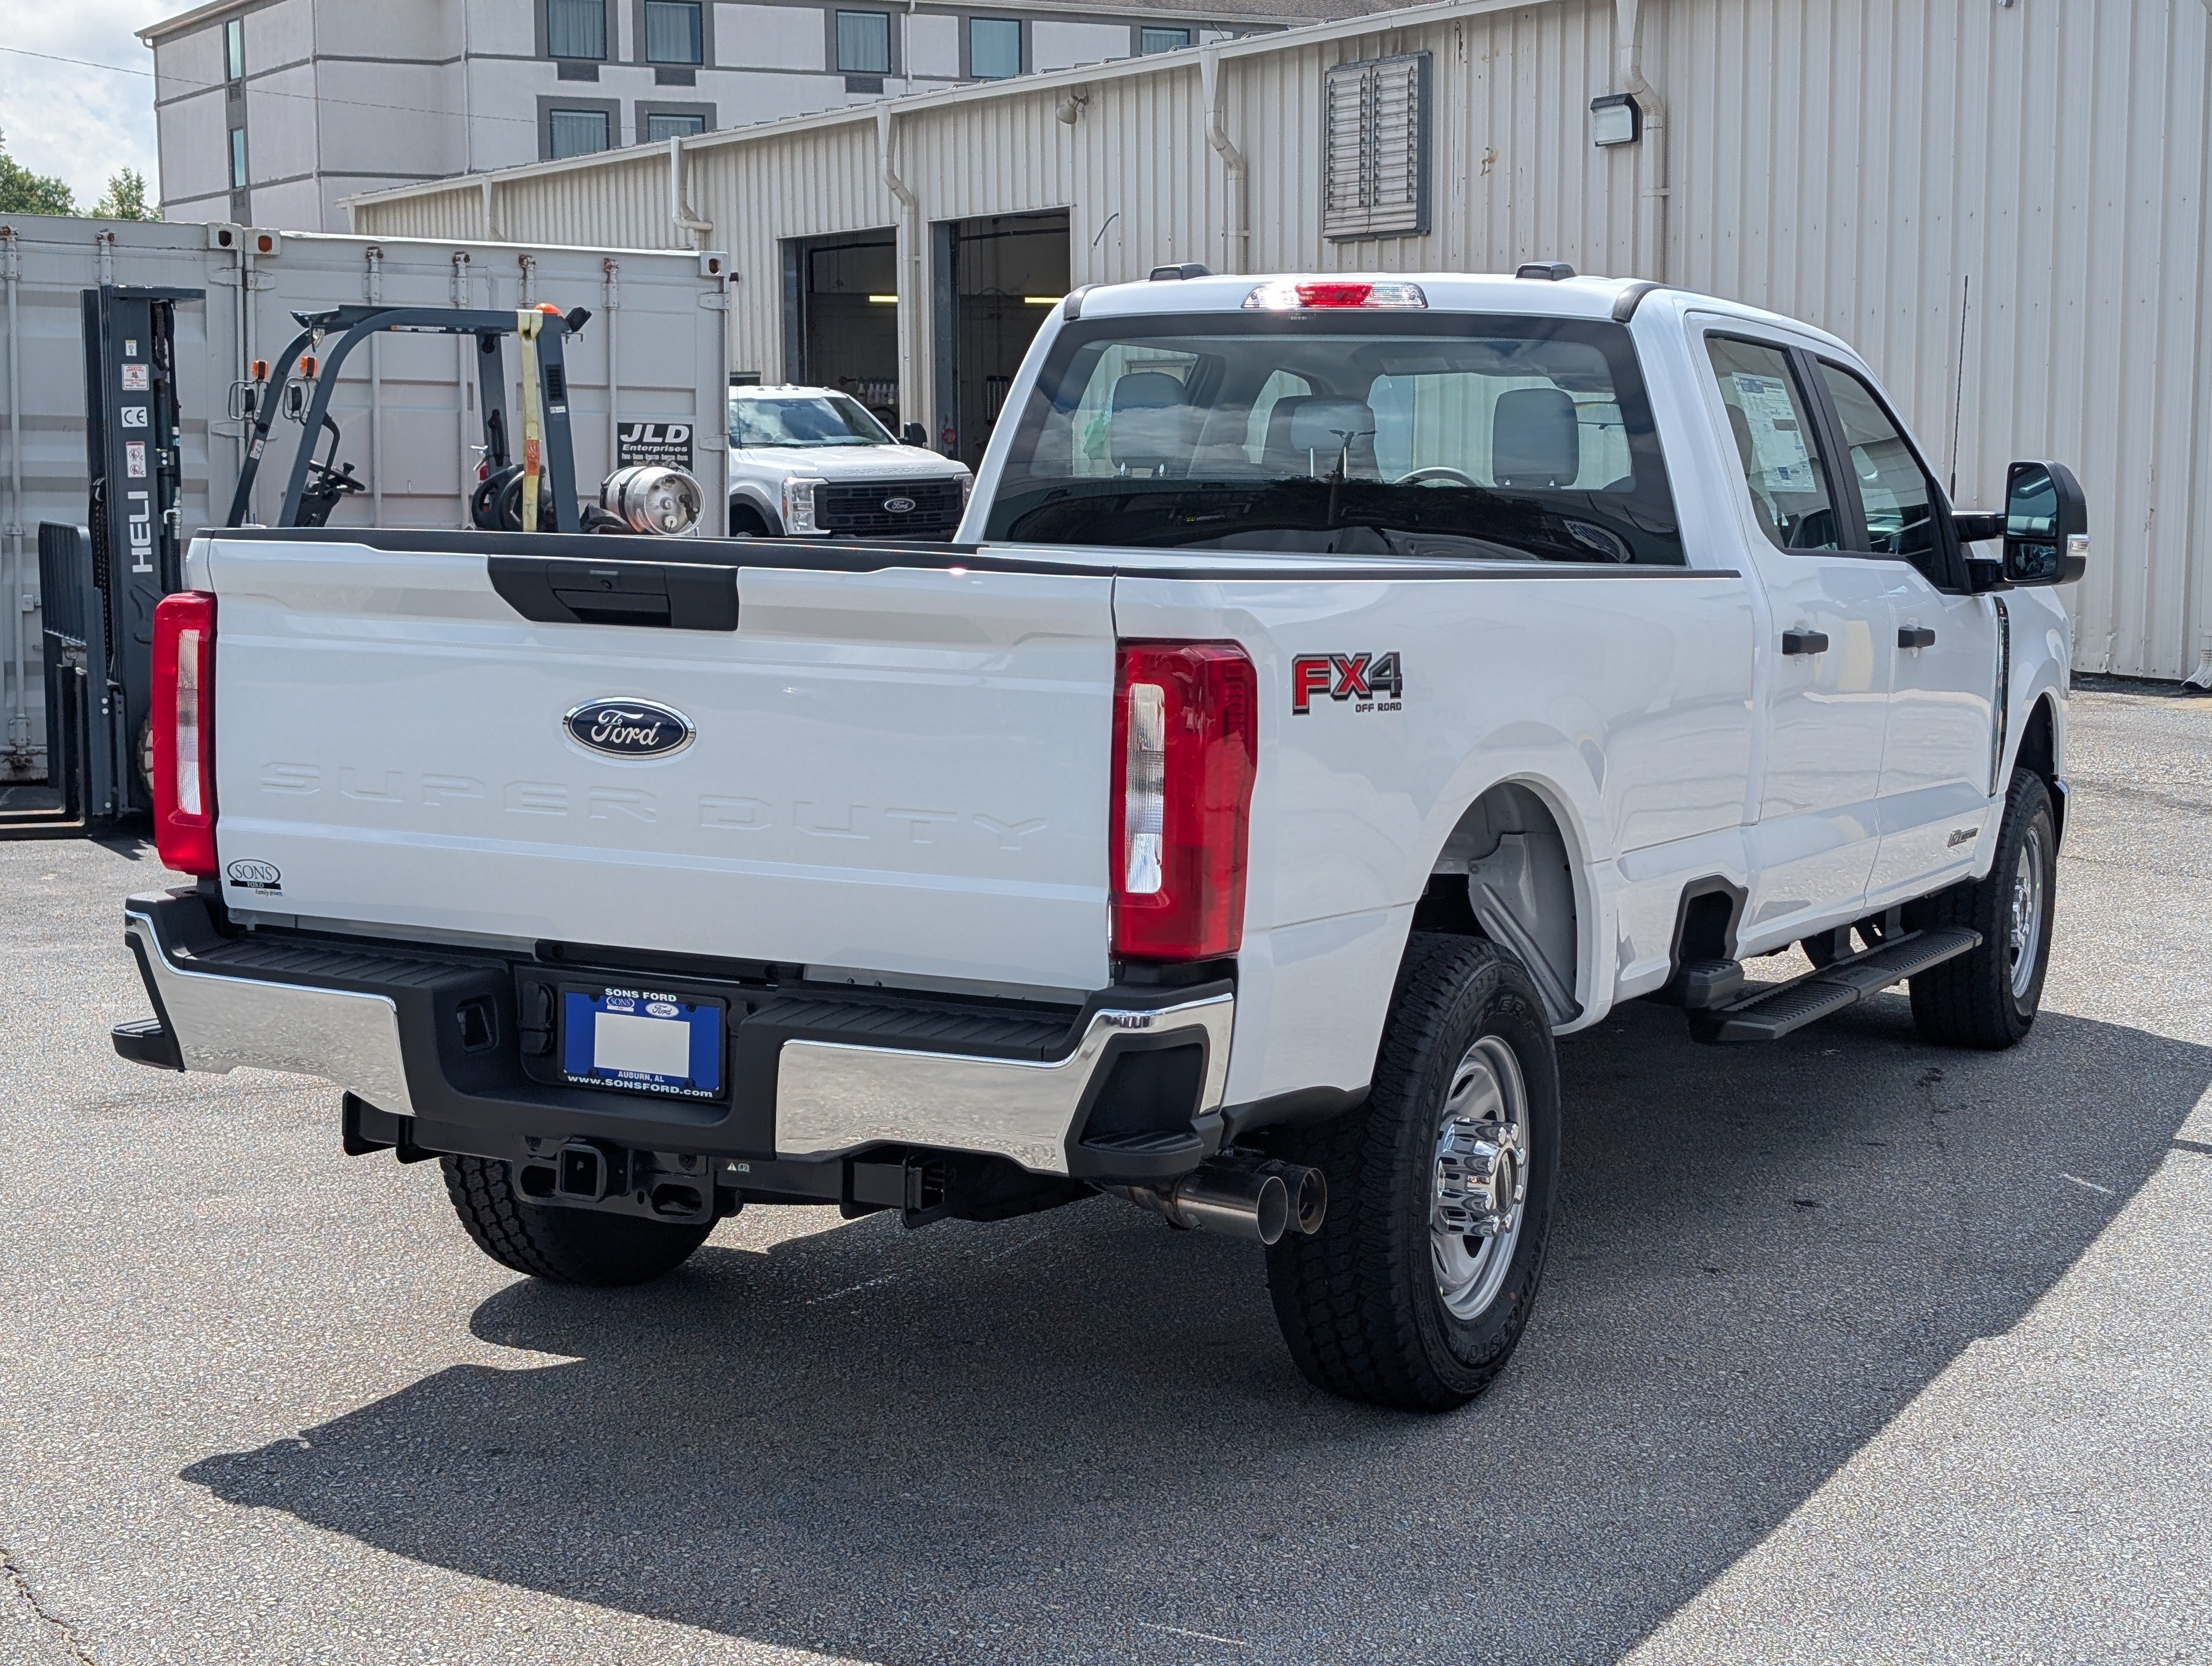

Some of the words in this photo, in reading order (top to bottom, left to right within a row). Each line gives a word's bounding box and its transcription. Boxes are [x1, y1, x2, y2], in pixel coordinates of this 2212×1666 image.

[620, 424, 690, 443] JLD
[622, 444, 687, 452] Enterprises
[892, 500, 909, 509] Ford
[127, 491, 153, 573] HELI
[1292, 651, 1403, 716] FX4
[1355, 703, 1374, 713] OFF
[1377, 702, 1402, 712] ROAD
[591, 709, 662, 746] Ford
[261, 761, 657, 823] SUPER
[699, 793, 1047, 850] DUTY
[235, 864, 273, 881] SONS
[605, 988, 639, 998] SONS
[643, 991, 677, 1002] FORD
[610, 997, 631, 1007] SONS
[652, 1004, 673, 1016] Ford
[618, 1071, 653, 1082] AUBURN,
[654, 1073, 665, 1082] AL
[568, 1075, 713, 1098] www.SONSFORD.com
